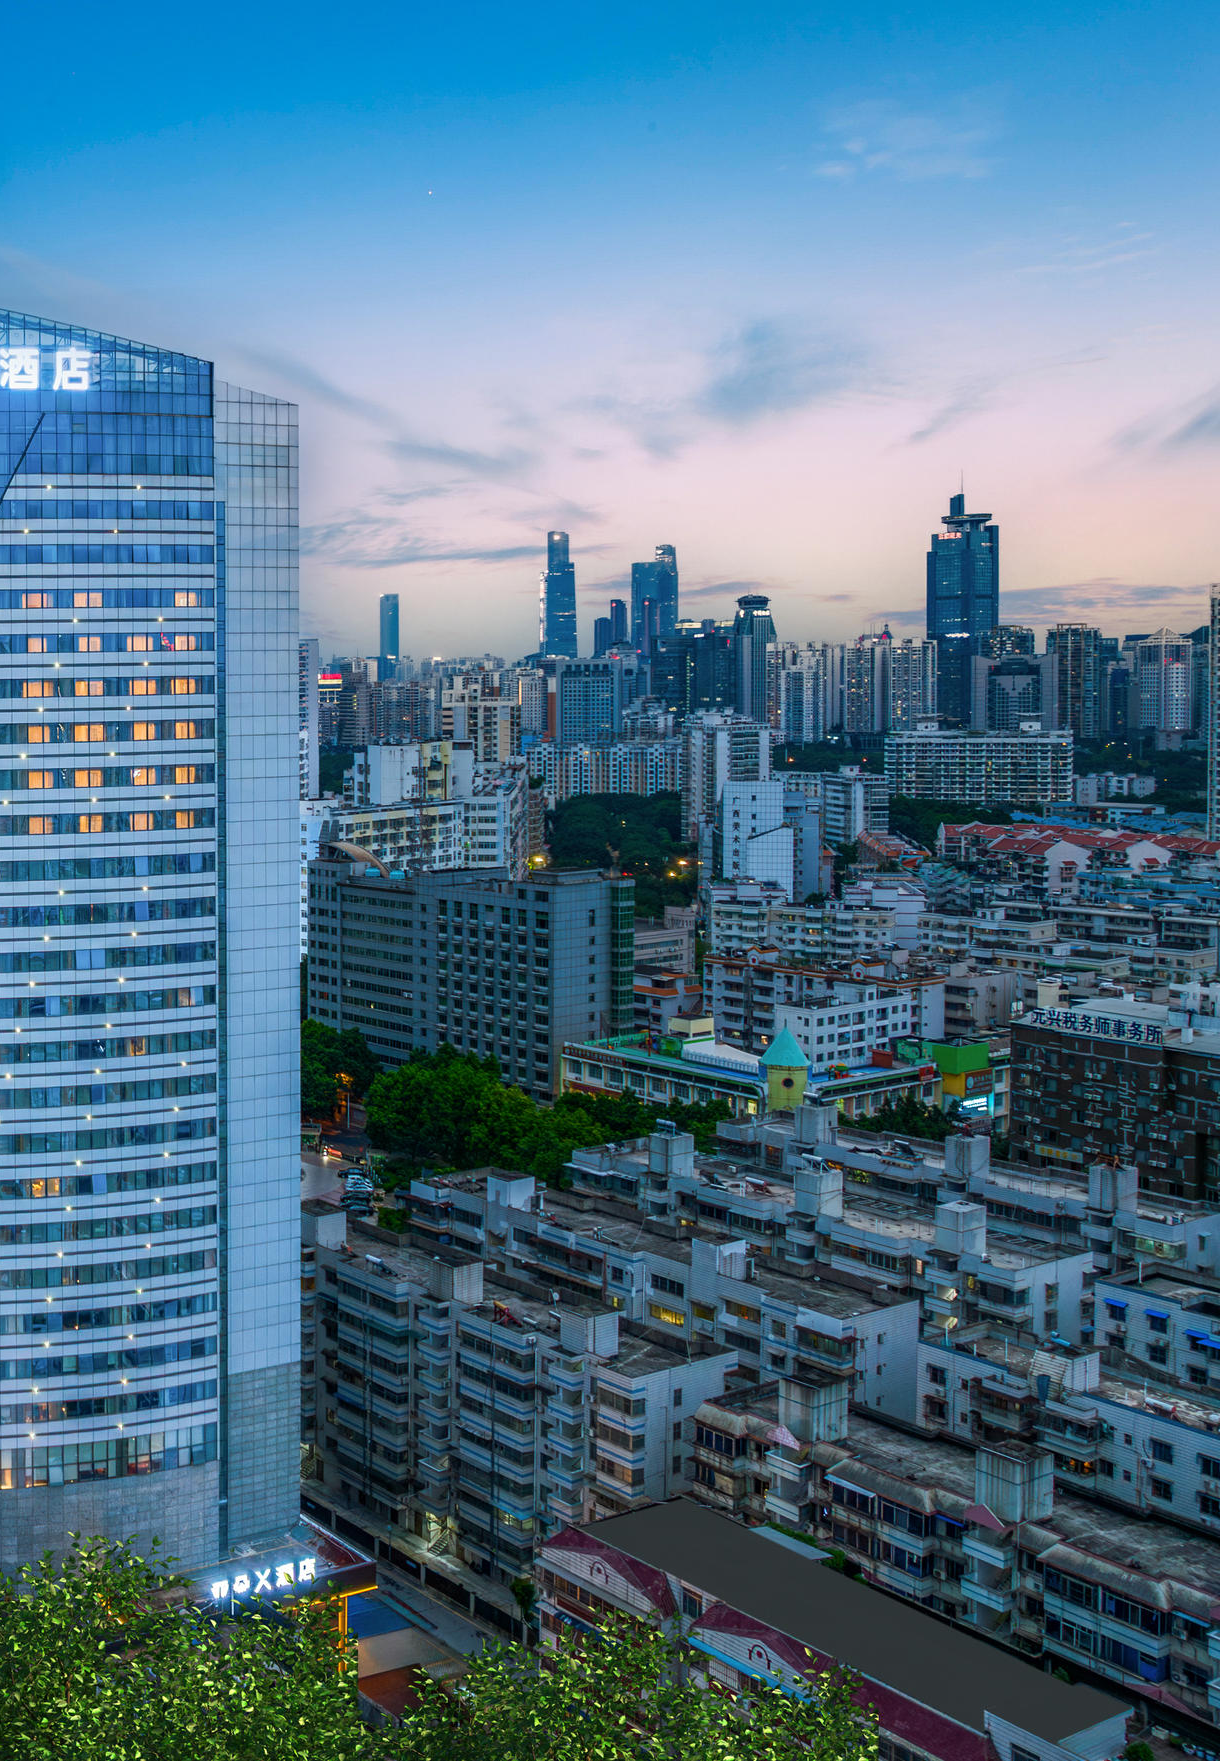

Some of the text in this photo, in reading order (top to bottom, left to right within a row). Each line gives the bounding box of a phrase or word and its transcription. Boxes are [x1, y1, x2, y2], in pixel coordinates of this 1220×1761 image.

[1031, 1007, 1164, 1045] 元兴税务师事务所
